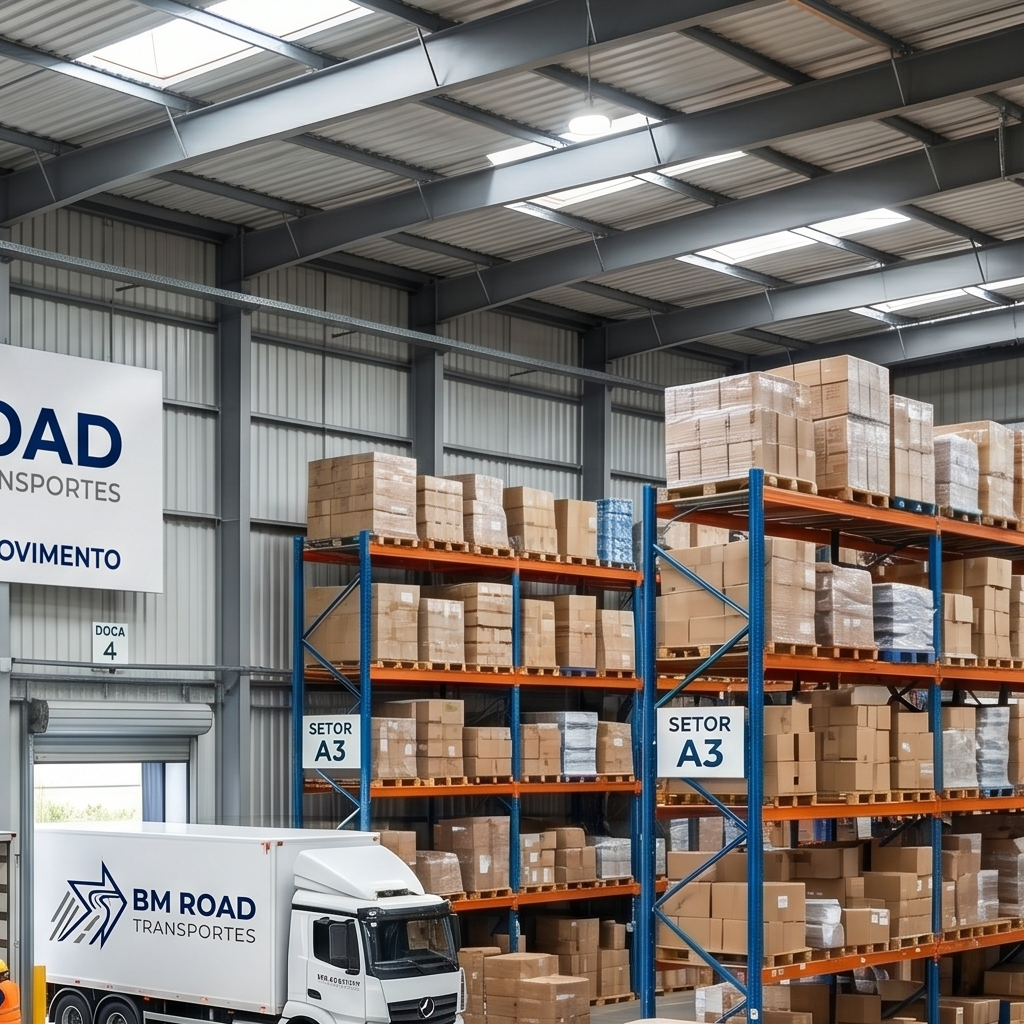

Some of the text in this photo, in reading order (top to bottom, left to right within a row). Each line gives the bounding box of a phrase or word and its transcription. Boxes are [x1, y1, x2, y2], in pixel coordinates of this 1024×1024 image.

[95, 624, 126, 637] DOCA
[102, 640, 117, 661] 4
[308, 722, 352, 736] SETOR
[668, 716, 731, 732] SETOR
[314, 739, 346, 762] A3
[676, 738, 724, 768] A3
[133, 888, 257, 921] BM ROAD
[132, 918, 256, 944] TRANSPORTES
